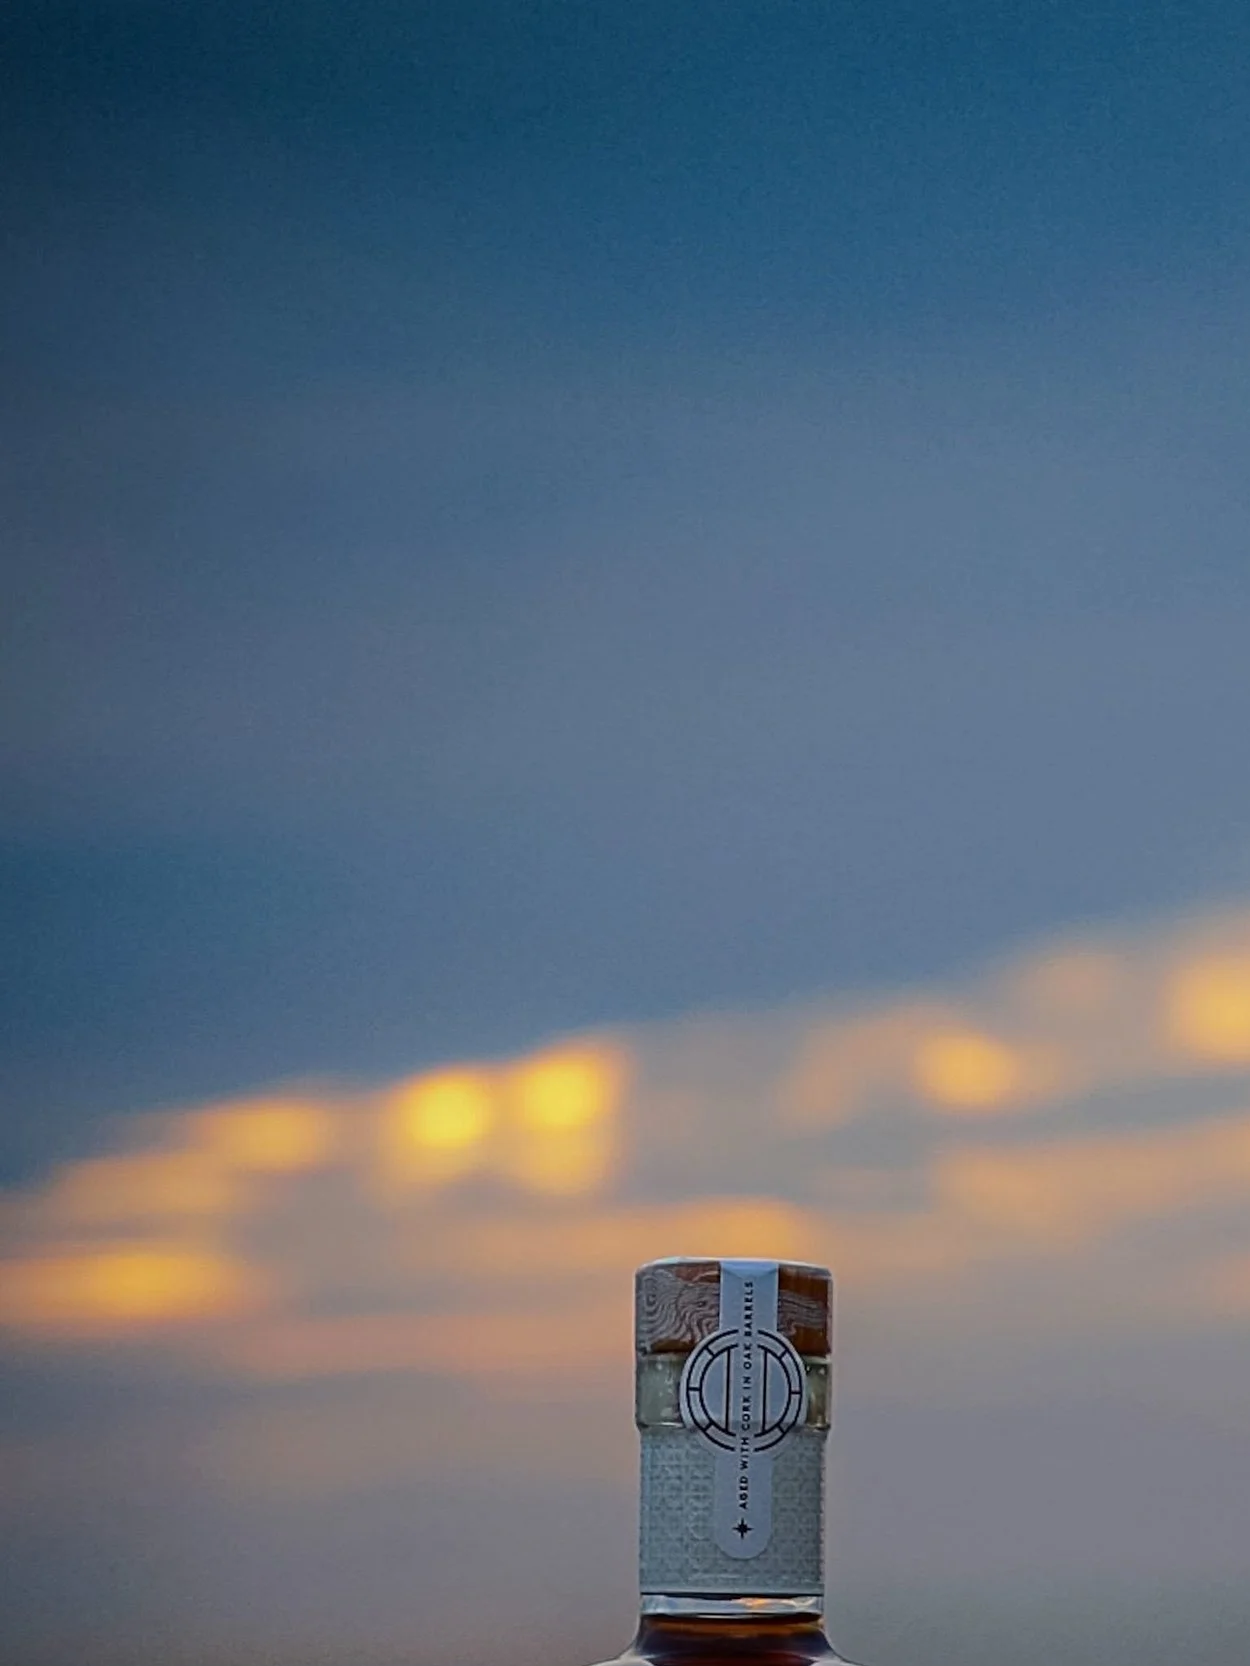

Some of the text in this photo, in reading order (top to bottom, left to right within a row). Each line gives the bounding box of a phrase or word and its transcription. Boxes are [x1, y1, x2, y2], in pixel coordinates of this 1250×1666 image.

[739, 1282, 754, 1510] AGED WITH CORK IN OAK BARRELS
